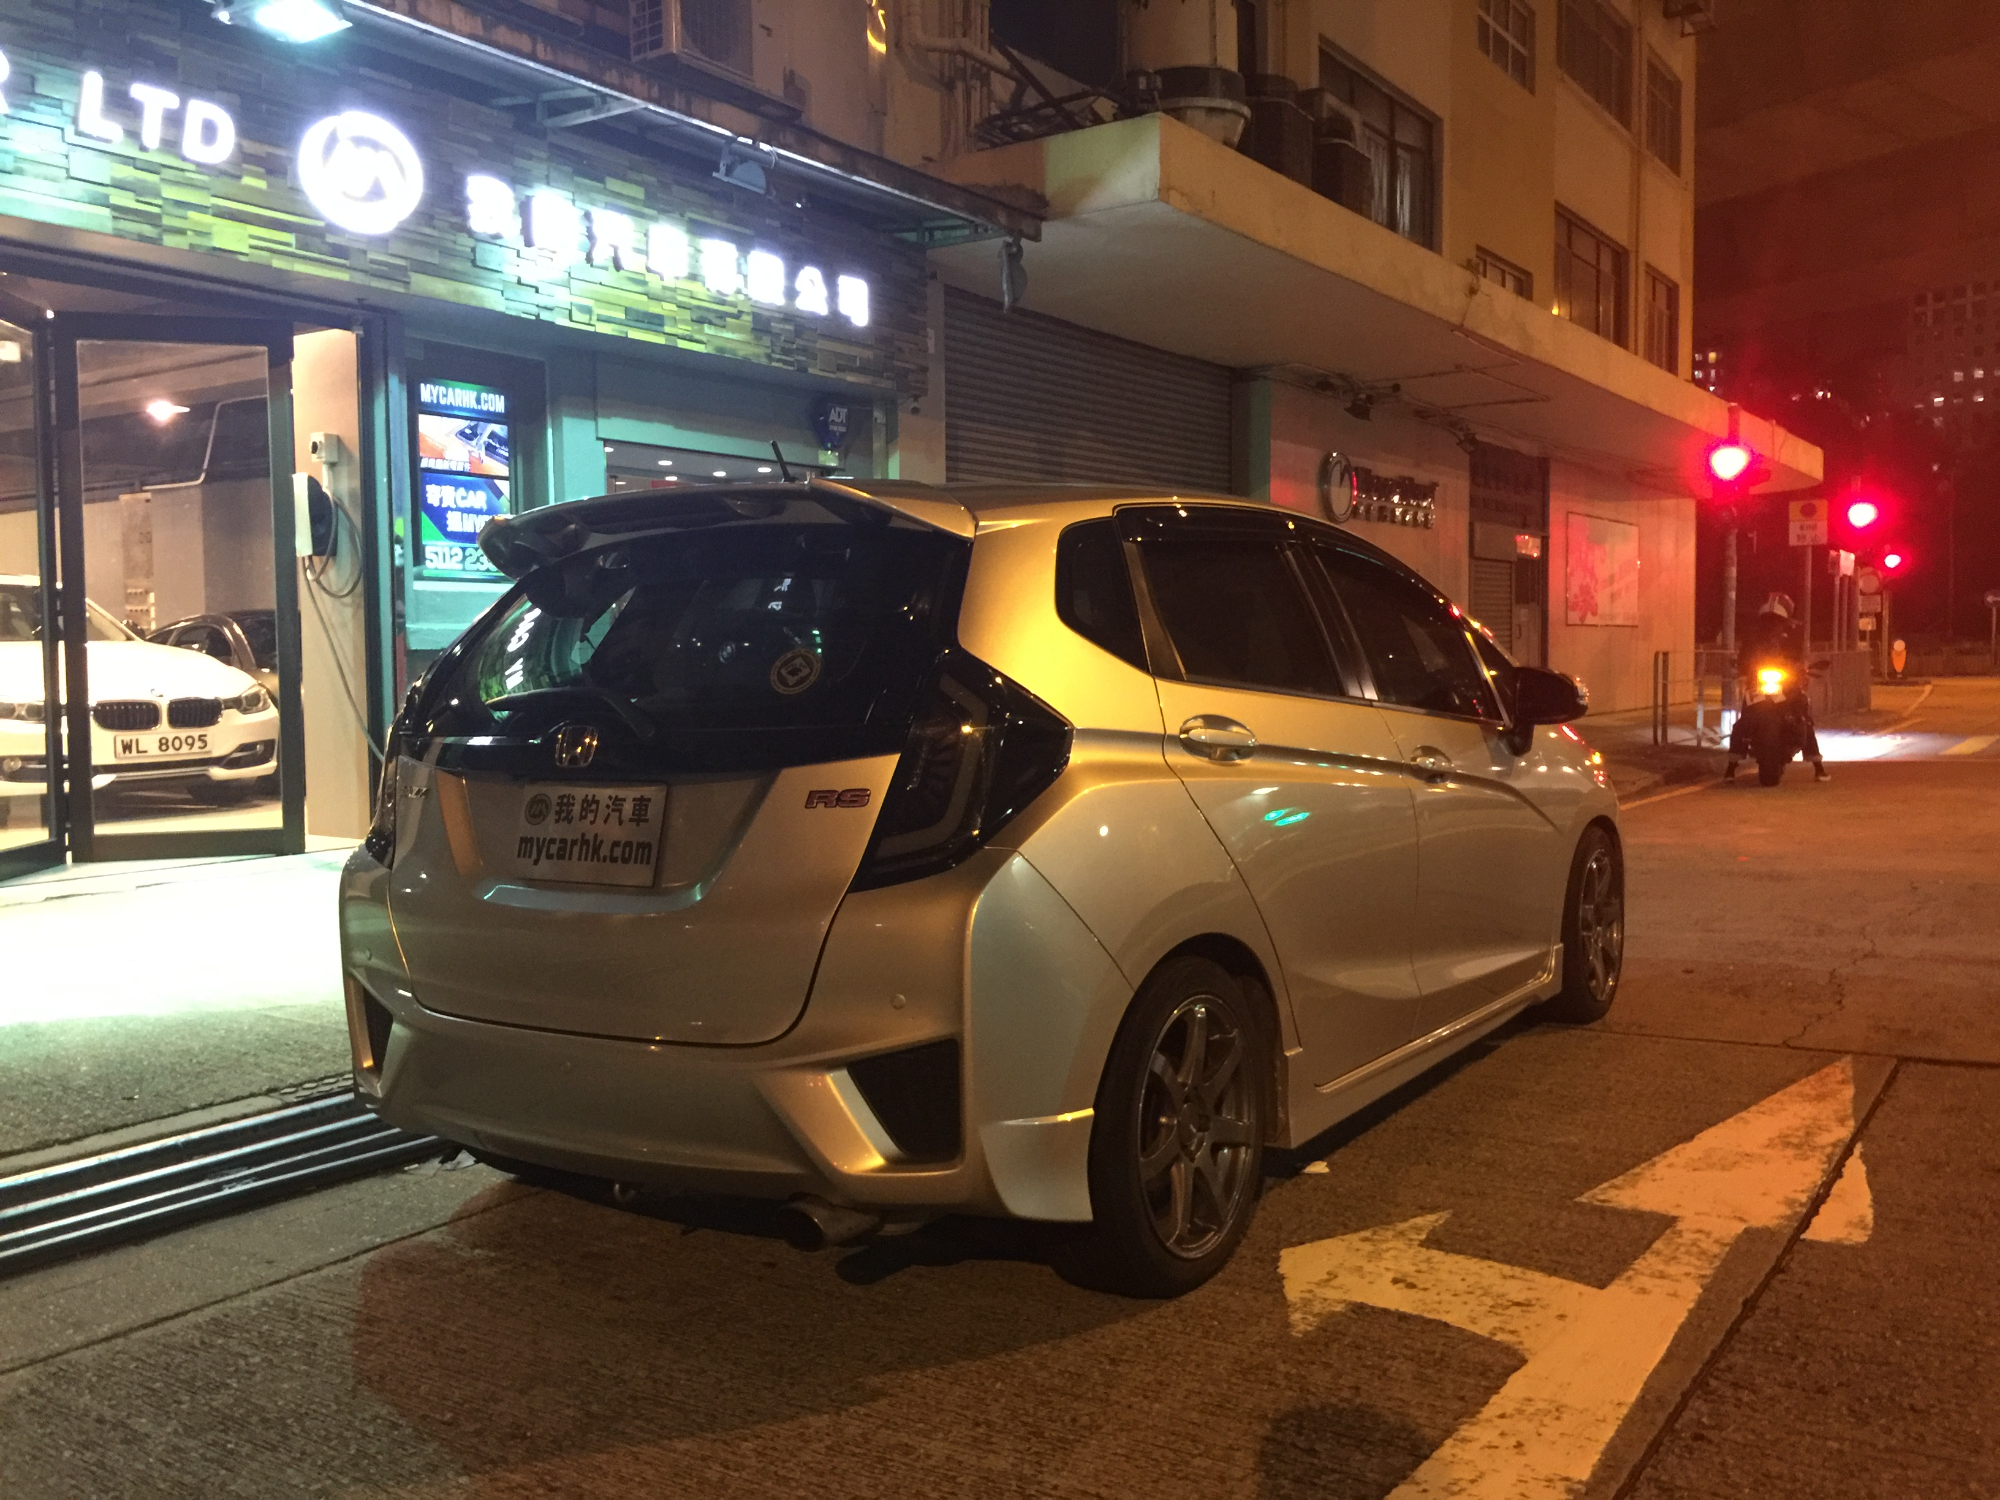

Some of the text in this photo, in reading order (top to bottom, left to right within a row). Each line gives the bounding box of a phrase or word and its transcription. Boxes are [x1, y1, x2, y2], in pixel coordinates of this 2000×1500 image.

[77, 71, 236, 164] LTD
[420, 383, 505, 413] MYCARHK.COM
[829, 407, 847, 424] ADT
[425, 546, 463, 570] 5112
[121, 733, 208, 754] WL 8095
[554, 793, 652, 827] 我的汽車
[805, 788, 871, 809] RS
[517, 832, 653, 866] mycarhk.com
